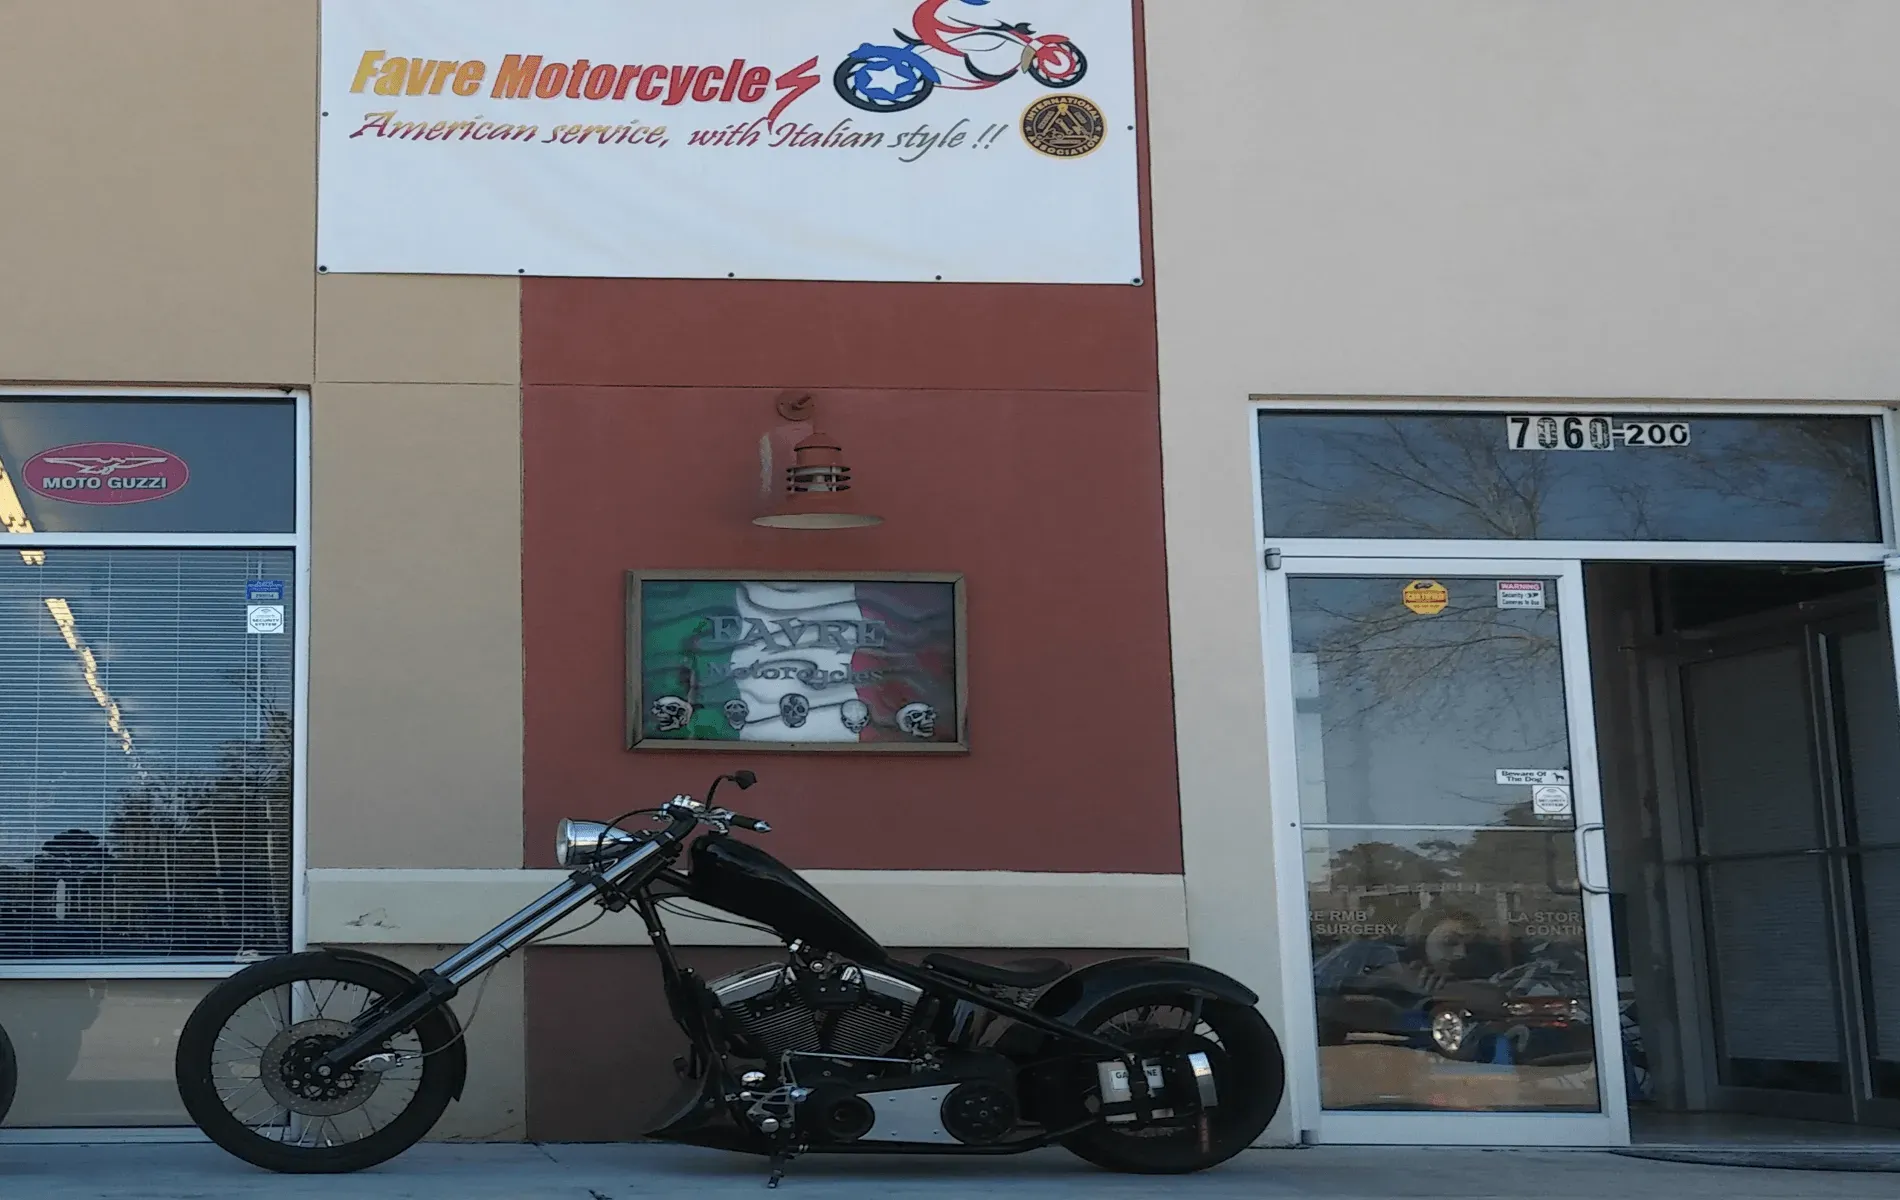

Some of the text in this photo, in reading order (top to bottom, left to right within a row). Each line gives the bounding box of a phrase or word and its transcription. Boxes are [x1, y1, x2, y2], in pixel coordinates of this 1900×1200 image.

[350, 50, 486, 96] Favre
[1026, 97, 1100, 121] INTERNATIONAL
[349, 110, 540, 142] American
[541, 119, 670, 148] service,
[687, 116, 769, 147] with
[767, 118, 885, 148] Italian
[887, 118, 970, 163] style
[1028, 135, 1100, 155] ASSOCIATION
[43, 477, 167, 489] MOTO GUZZI
[706, 616, 886, 654] FAVRE
[707, 659, 884, 690] Motorcycles
[1329, 910, 1367, 921] RMB
[1316, 923, 1398, 935] SURGERY
